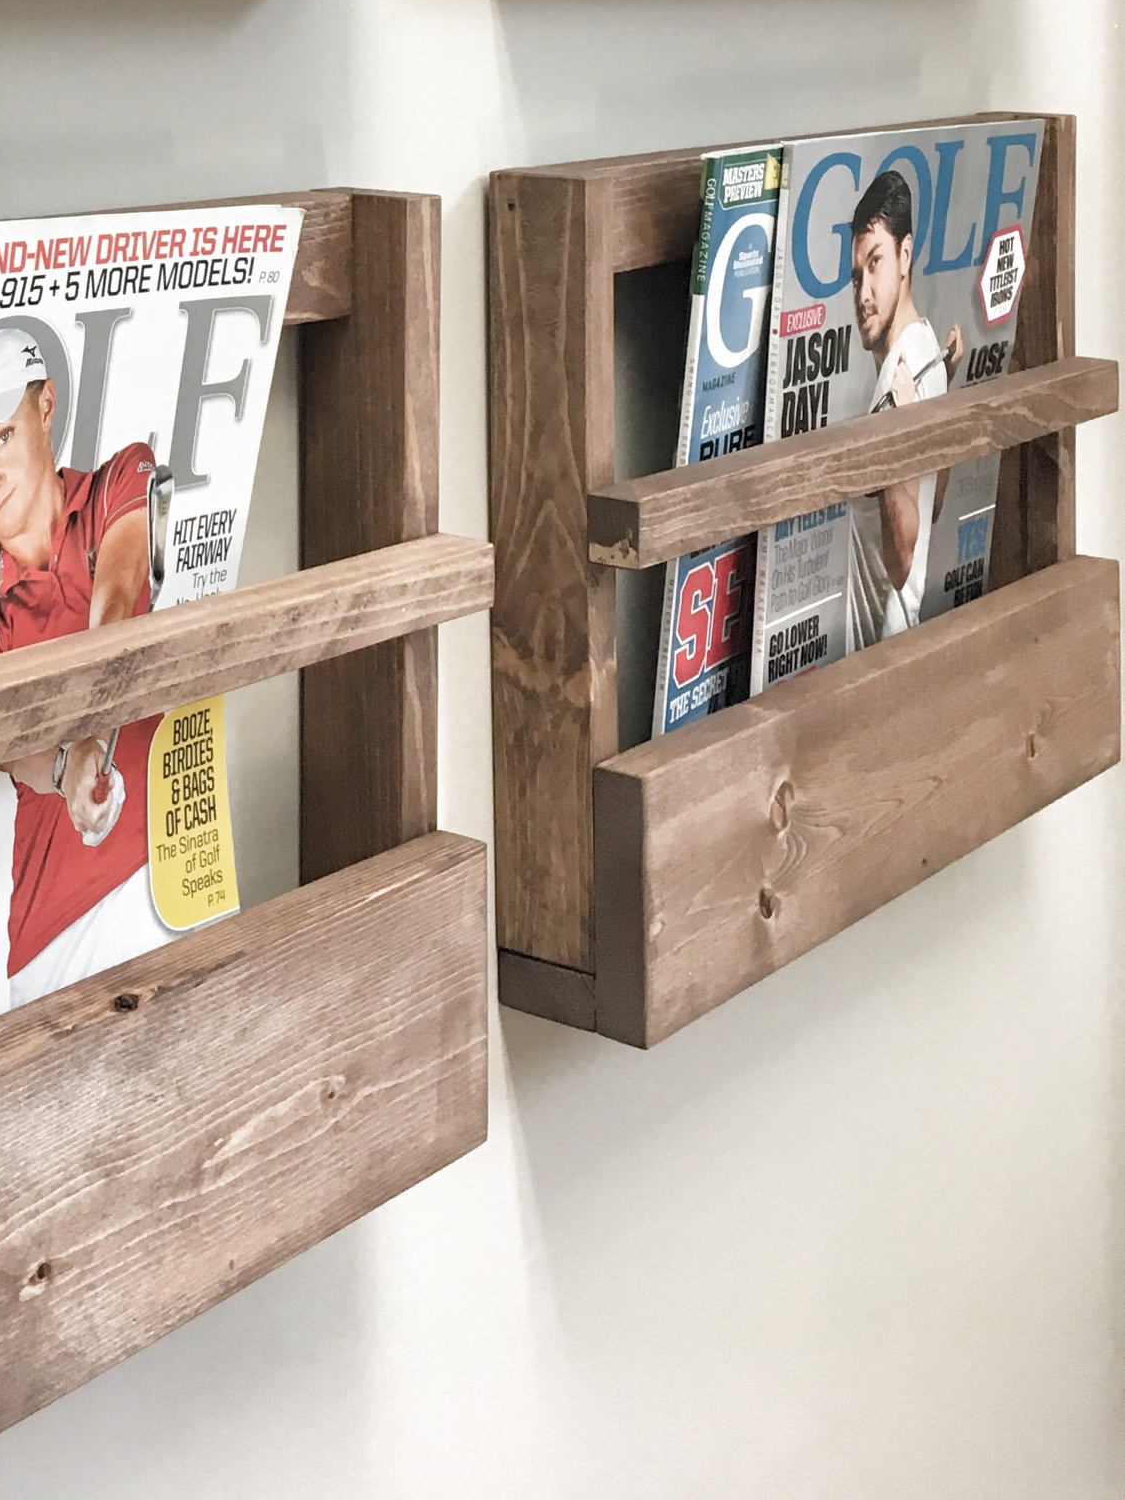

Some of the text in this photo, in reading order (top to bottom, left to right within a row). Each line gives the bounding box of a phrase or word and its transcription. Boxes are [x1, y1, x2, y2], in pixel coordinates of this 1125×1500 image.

[723, 163, 765, 186] MASTERS
[723, 180, 763, 204] PREVIEW
[792, 132, 1036, 300] GOLF
[95, 229, 187, 265] DRIVER
[190, 226, 218, 255] IS
[221, 224, 287, 255] HERE
[996, 253, 1014, 273] NEW
[999, 237, 1015, 256] HOT
[48, 281, 62, 297] +
[64, 271, 81, 301] 5
[84, 263, 151, 300] MORE
[156, 256, 256, 292] MODELS!
[706, 212, 774, 369] G
[989, 268, 1019, 292] TITLEIST
[990, 286, 1014, 308] IRONS
[787, 307, 824, 333] EXCLUSIVE
[783, 324, 852, 389] JASON
[966, 340, 1008, 382] LOSE
[702, 372, 736, 392] MAGAZINE
[700, 396, 750, 439] Exclusive
[781, 380, 829, 439] DAY!
[173, 508, 237, 546] HIT EVERY
[176, 536, 232, 573] FAIRWAY
[193, 568, 227, 589] Try the
[945, 564, 966, 592] GOLF
[769, 615, 819, 658] GO LOWER
[768, 634, 827, 684] RIGHT NOW!
[670, 667, 730, 723] THE SECRET
[173, 708, 213, 746] BOOZE,
[163, 736, 213, 779] BIRDIES
[172, 765, 215, 804] & BAGS
[166, 795, 217, 837] OF CASH
[156, 828, 219, 863] The Sinatra
[186, 844, 221, 874] of Golf
[182, 869, 223, 898] Speaks
[215, 890, 225, 906] 74
